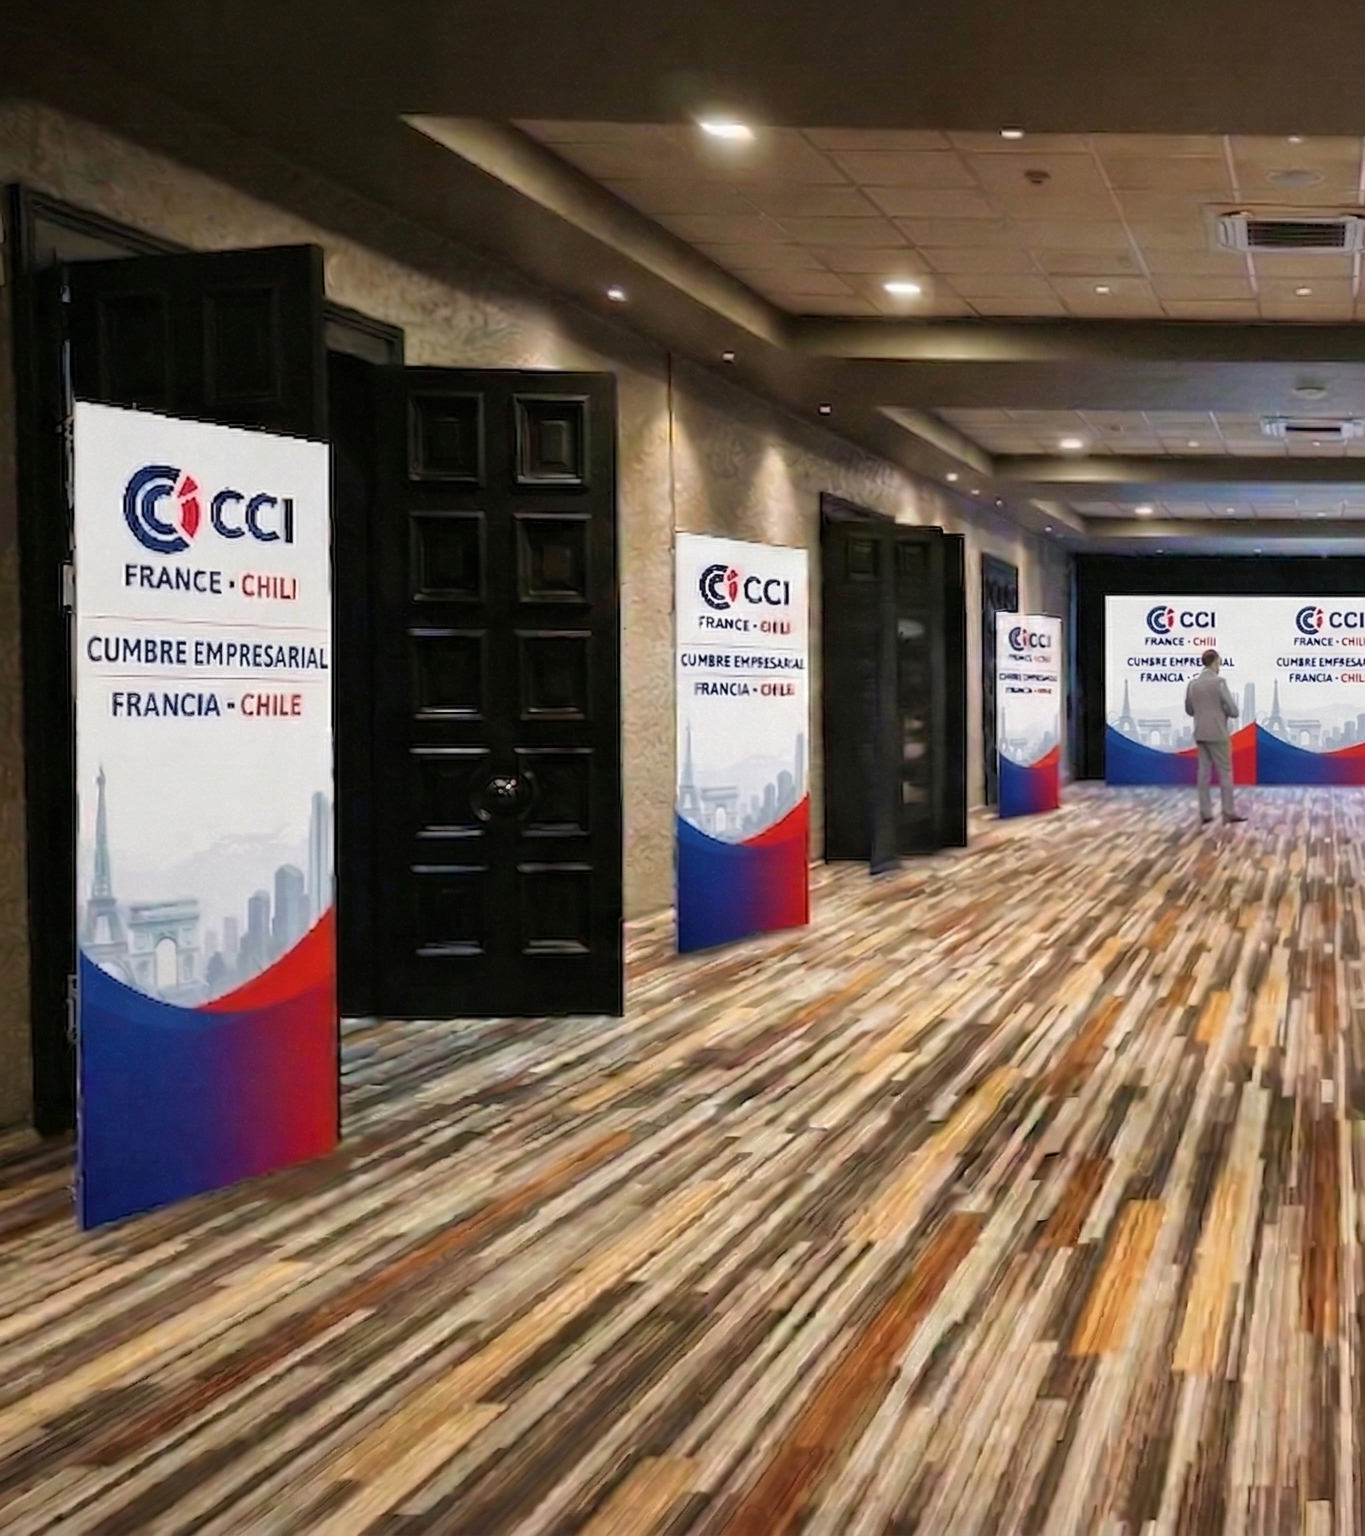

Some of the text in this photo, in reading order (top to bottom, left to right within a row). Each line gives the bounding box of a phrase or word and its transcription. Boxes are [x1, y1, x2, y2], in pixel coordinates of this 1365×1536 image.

[211, 489, 294, 543] CCI
[125, 564, 223, 594] FRANCE
[242, 574, 298, 600] CHILI
[744, 576, 790, 606] CCI
[699, 616, 750, 632] FRANCE
[1180, 611, 1215, 628] CCI
[1329, 611, 1364, 628] CCI
[1145, 637, 1184, 646] FRANCE
[1294, 637, 1333, 646] FRANCE
[87, 636, 328, 669] CUMBRE EMPRESARIAL
[681, 653, 731, 668] CUMBRE
[1140, 672, 1184, 682] FRANCIA
[1289, 672, 1332, 682] FRANCIA
[694, 682, 750, 696] FRANCIA
[112, 692, 221, 717] FRANCIA
[241, 693, 302, 717] CHILE
